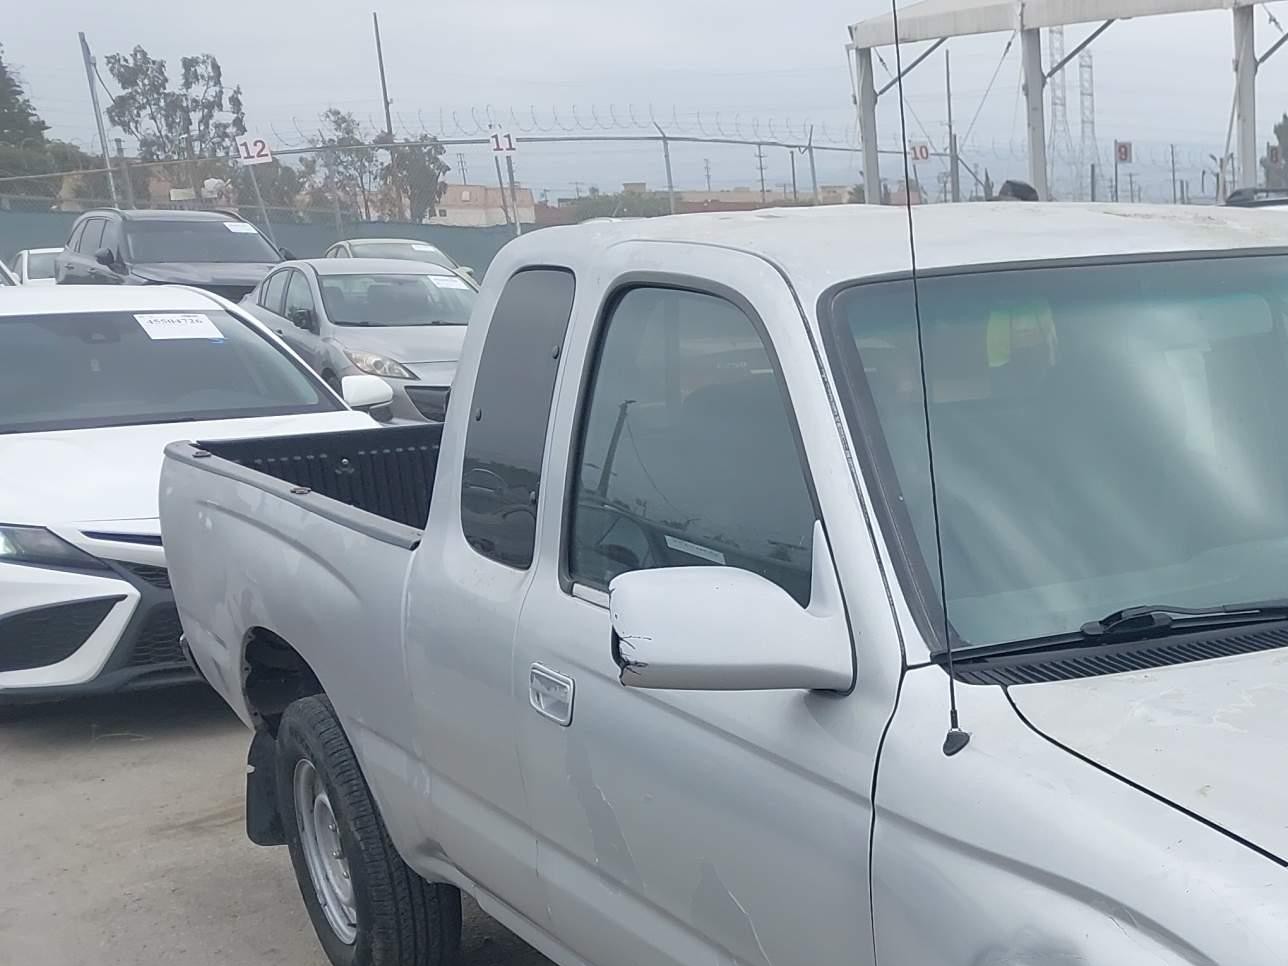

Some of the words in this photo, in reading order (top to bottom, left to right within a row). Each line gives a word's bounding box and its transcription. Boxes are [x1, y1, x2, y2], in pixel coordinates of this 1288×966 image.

[239, 139, 269, 160] 12
[491, 133, 516, 151] 11
[911, 145, 929, 160] 10
[1118, 144, 1128, 161] 9
